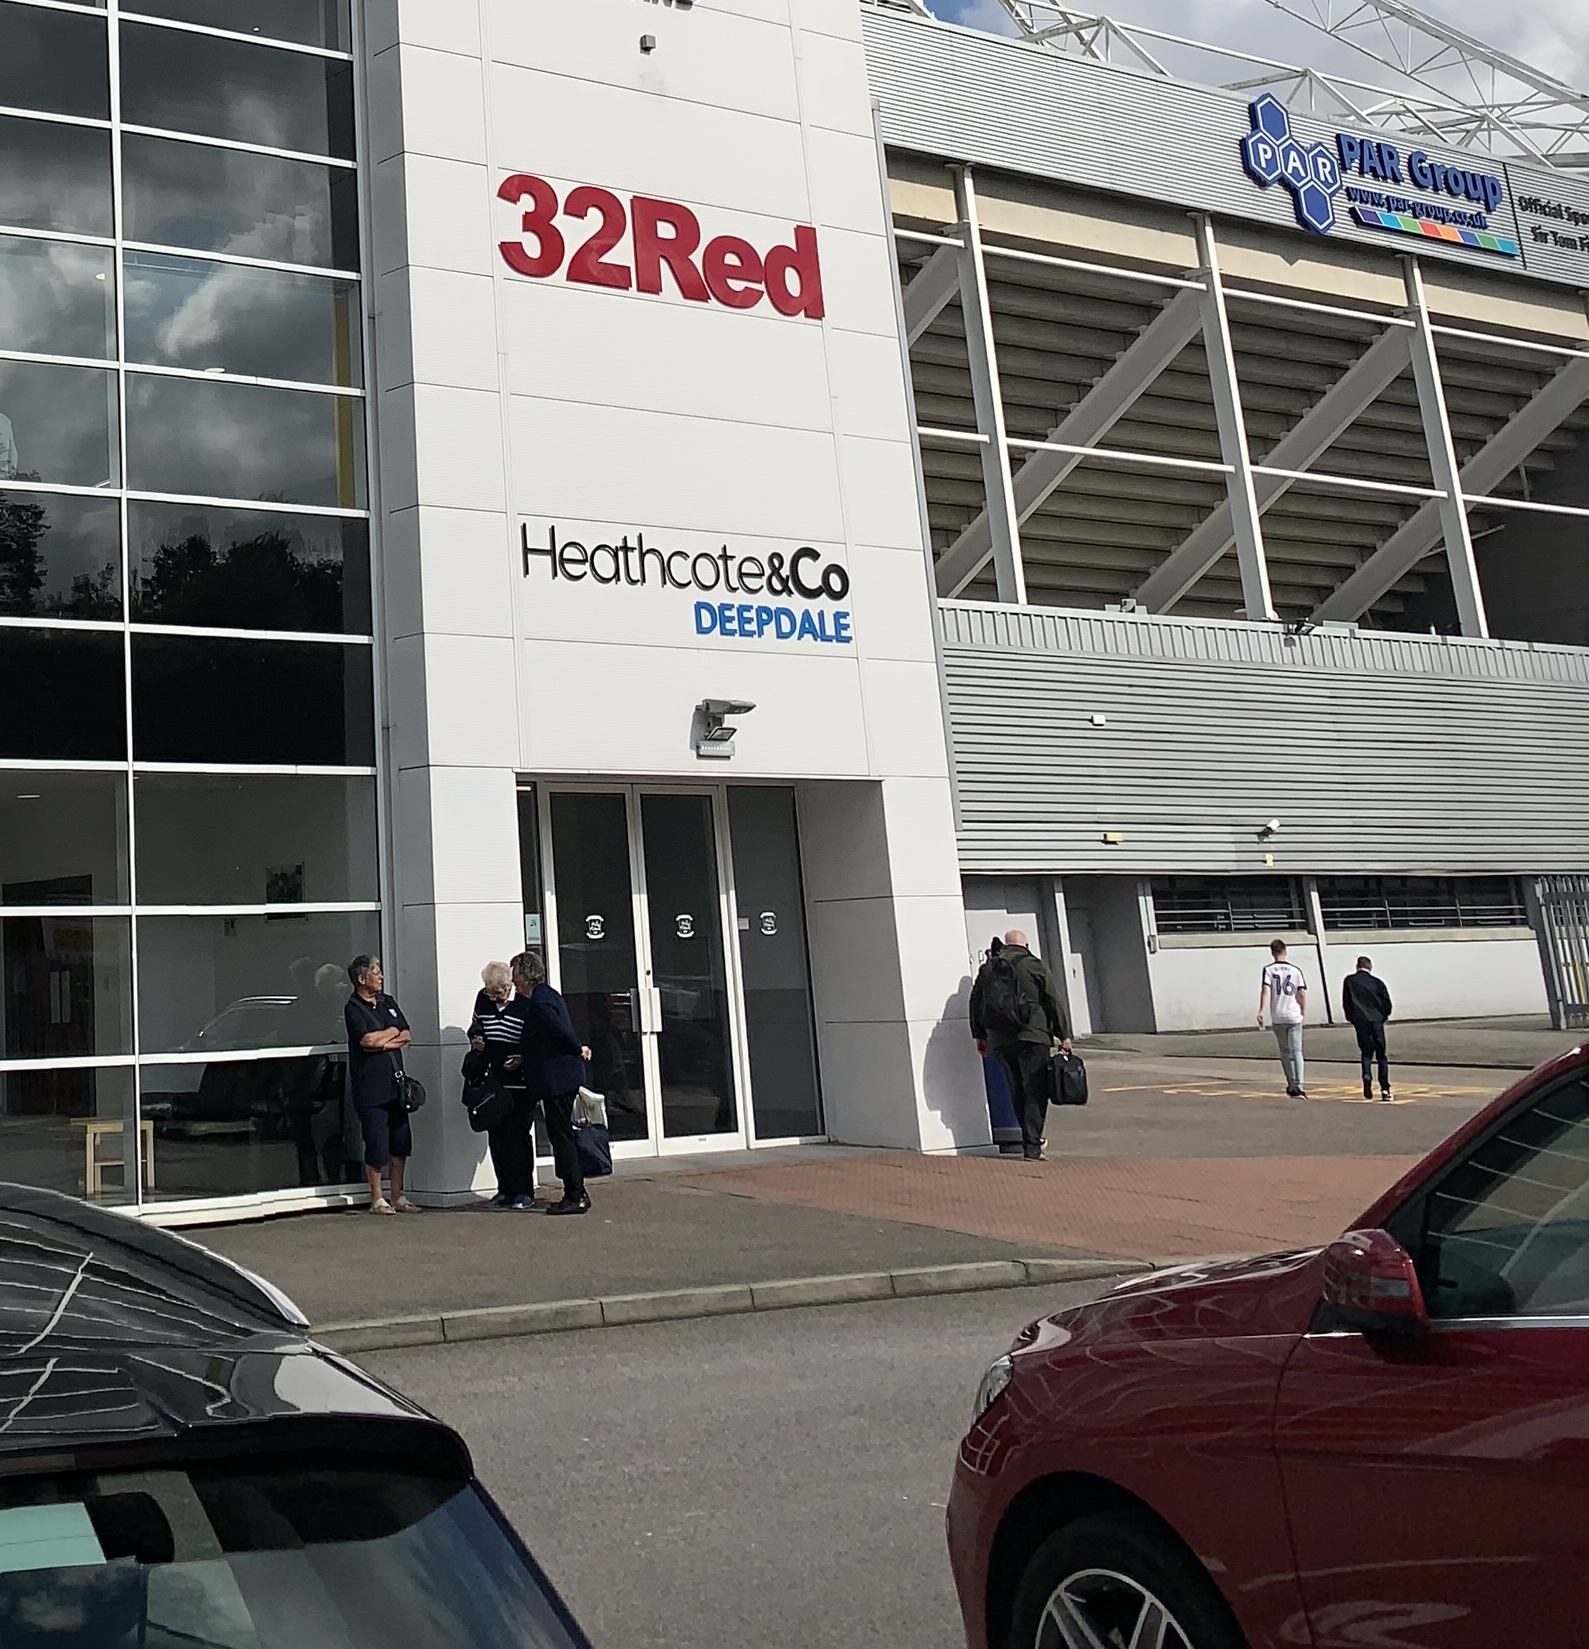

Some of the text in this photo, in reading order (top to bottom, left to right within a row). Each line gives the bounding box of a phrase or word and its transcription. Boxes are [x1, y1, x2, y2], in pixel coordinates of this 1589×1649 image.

[1257, 140, 1335, 186] PAR
[1336, 133, 1503, 213] PAR Group
[496, 173, 825, 320] 32Red
[519, 522, 851, 601] Heathcote&Co
[693, 600, 854, 645] DEEPDALE
[1272, 974, 1296, 996] 16
